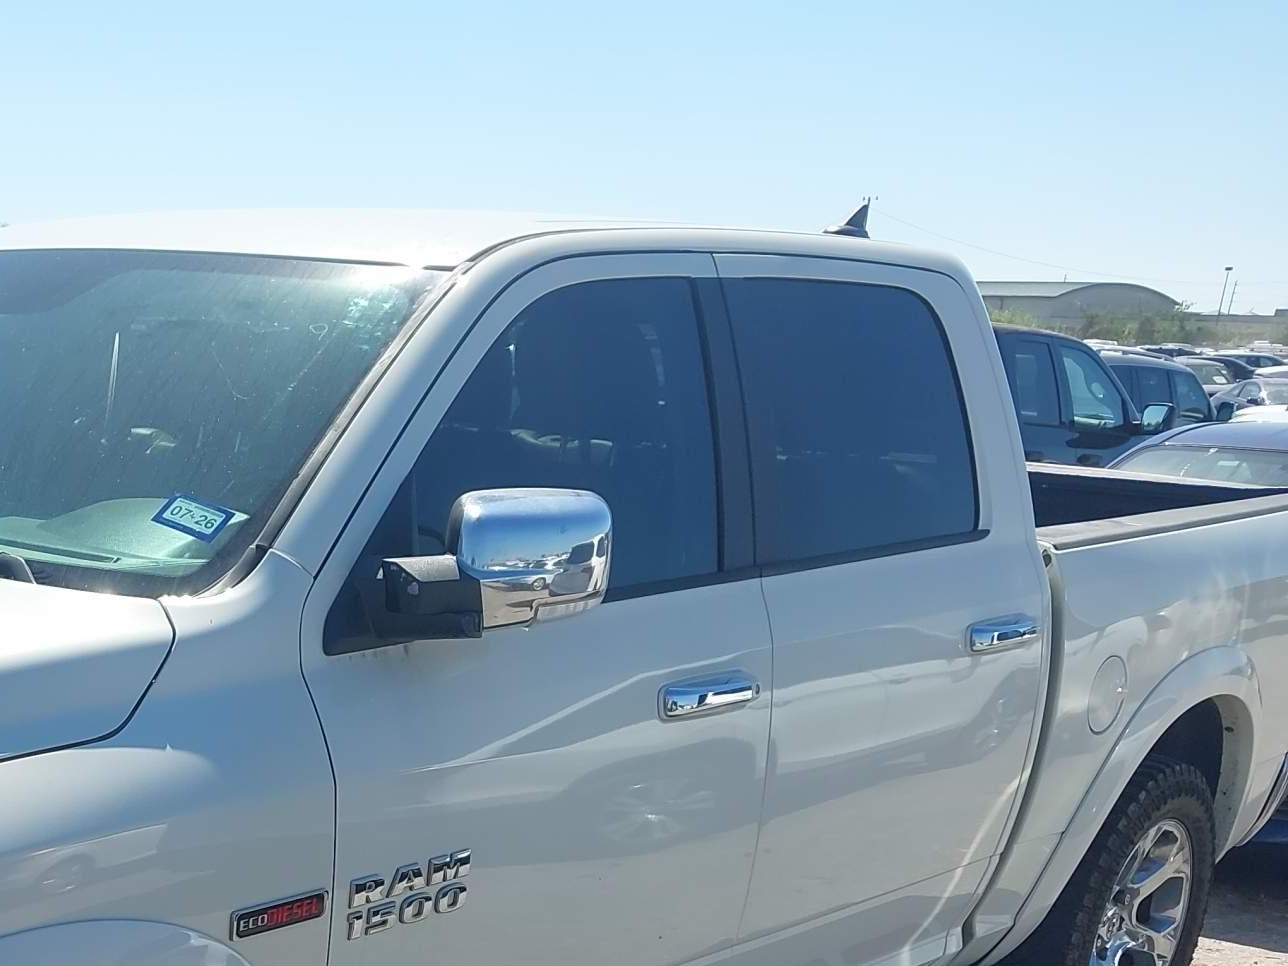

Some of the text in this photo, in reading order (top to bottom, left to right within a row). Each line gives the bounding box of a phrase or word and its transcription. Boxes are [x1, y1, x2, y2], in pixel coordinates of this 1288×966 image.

[348, 848, 472, 909] RAM
[238, 897, 321, 932] ECODIESEL
[347, 882, 469, 940] 1500
